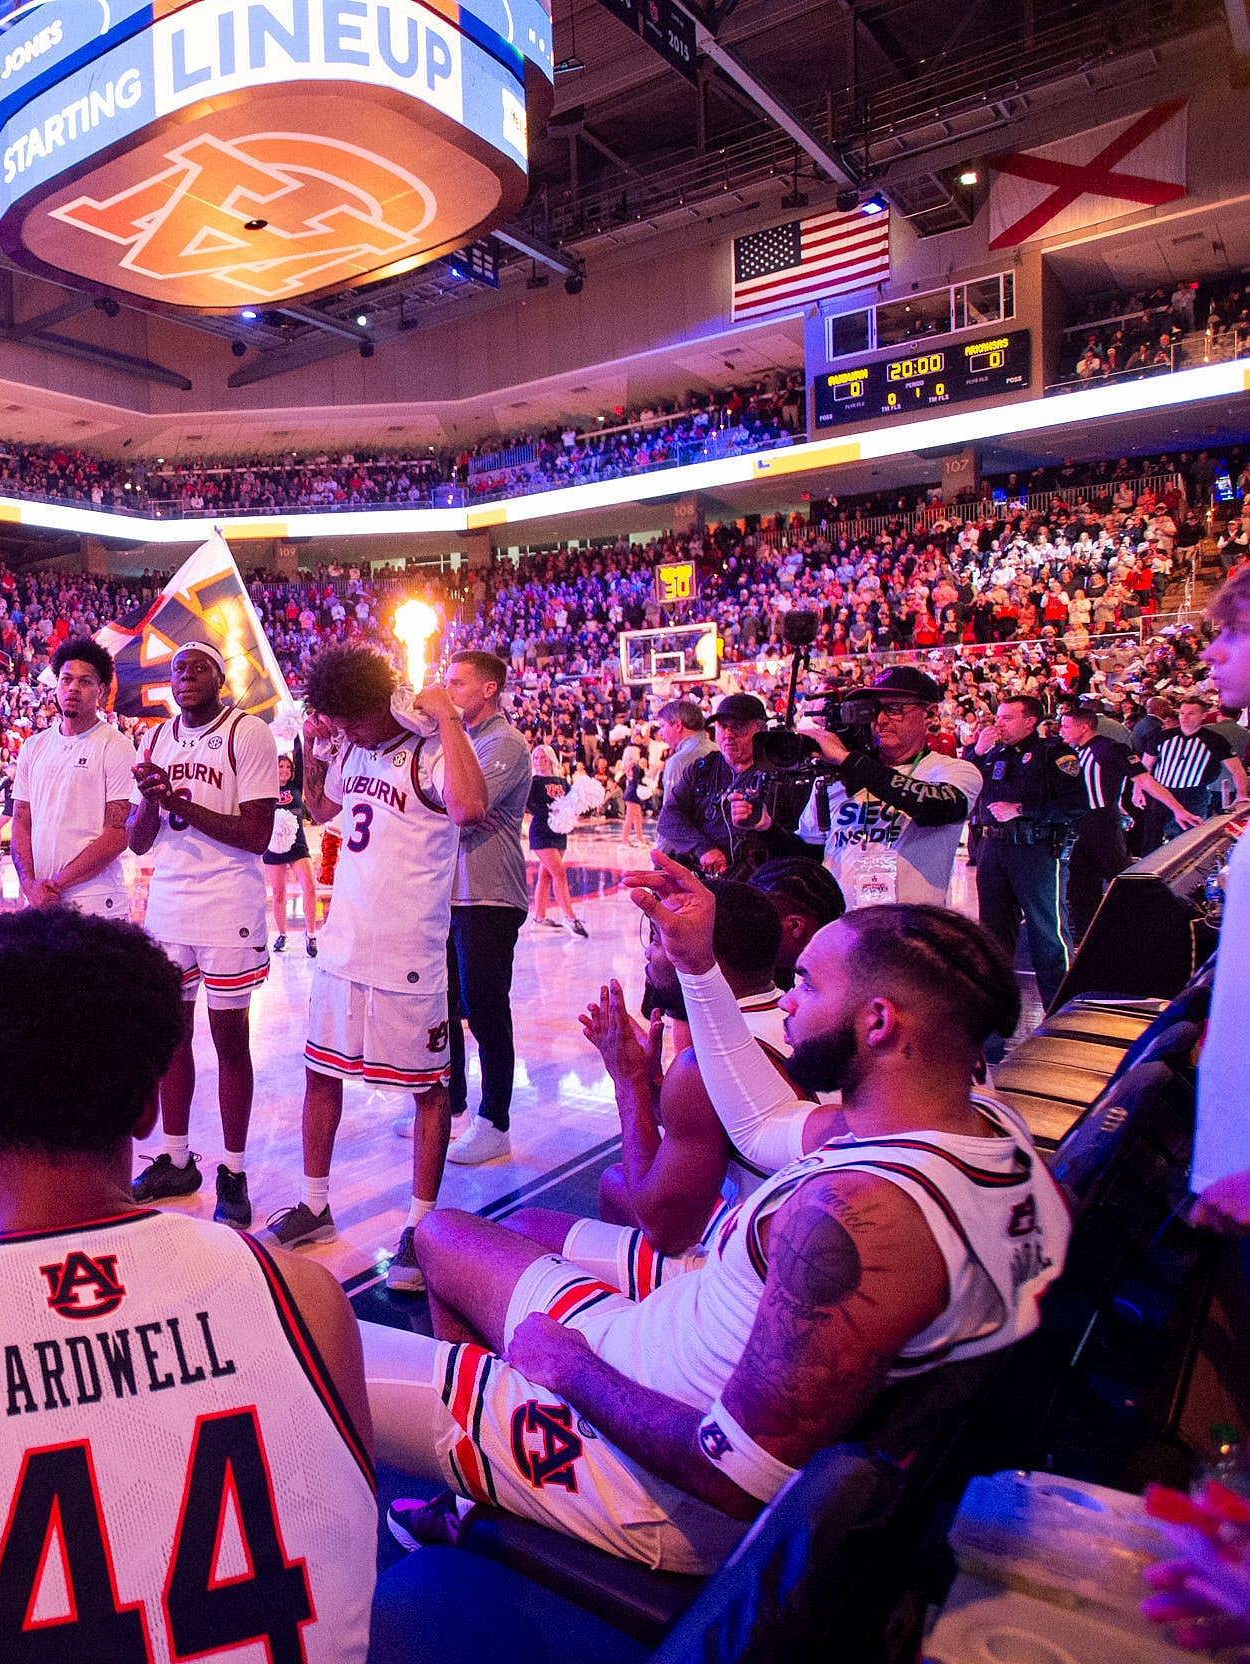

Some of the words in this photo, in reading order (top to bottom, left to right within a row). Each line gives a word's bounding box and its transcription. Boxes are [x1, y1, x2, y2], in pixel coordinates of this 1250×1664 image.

[2, 19, 63, 79] JONES
[668, 29, 690, 61] 2015
[3, 68, 141, 183] STARTING
[171, 0, 452, 94] LINEUP
[965, 338, 1009, 356] ARKANSAS
[890, 354, 941, 380] 20:00
[989, 352, 1001, 368] 0
[827, 368, 869, 387] AUBURN
[850, 381, 861, 397] 0
[887, 392, 897, 406] 0
[935, 383, 945, 396] 0
[945, 459, 969, 474] 107
[279, 547, 296, 558] 109
[167, 763, 223, 790] BURN
[837, 801, 898, 825] SEC
[347, 803, 373, 853] 3
[834, 826, 900, 847] INSIDE
[39, 1251, 127, 1320] AU
